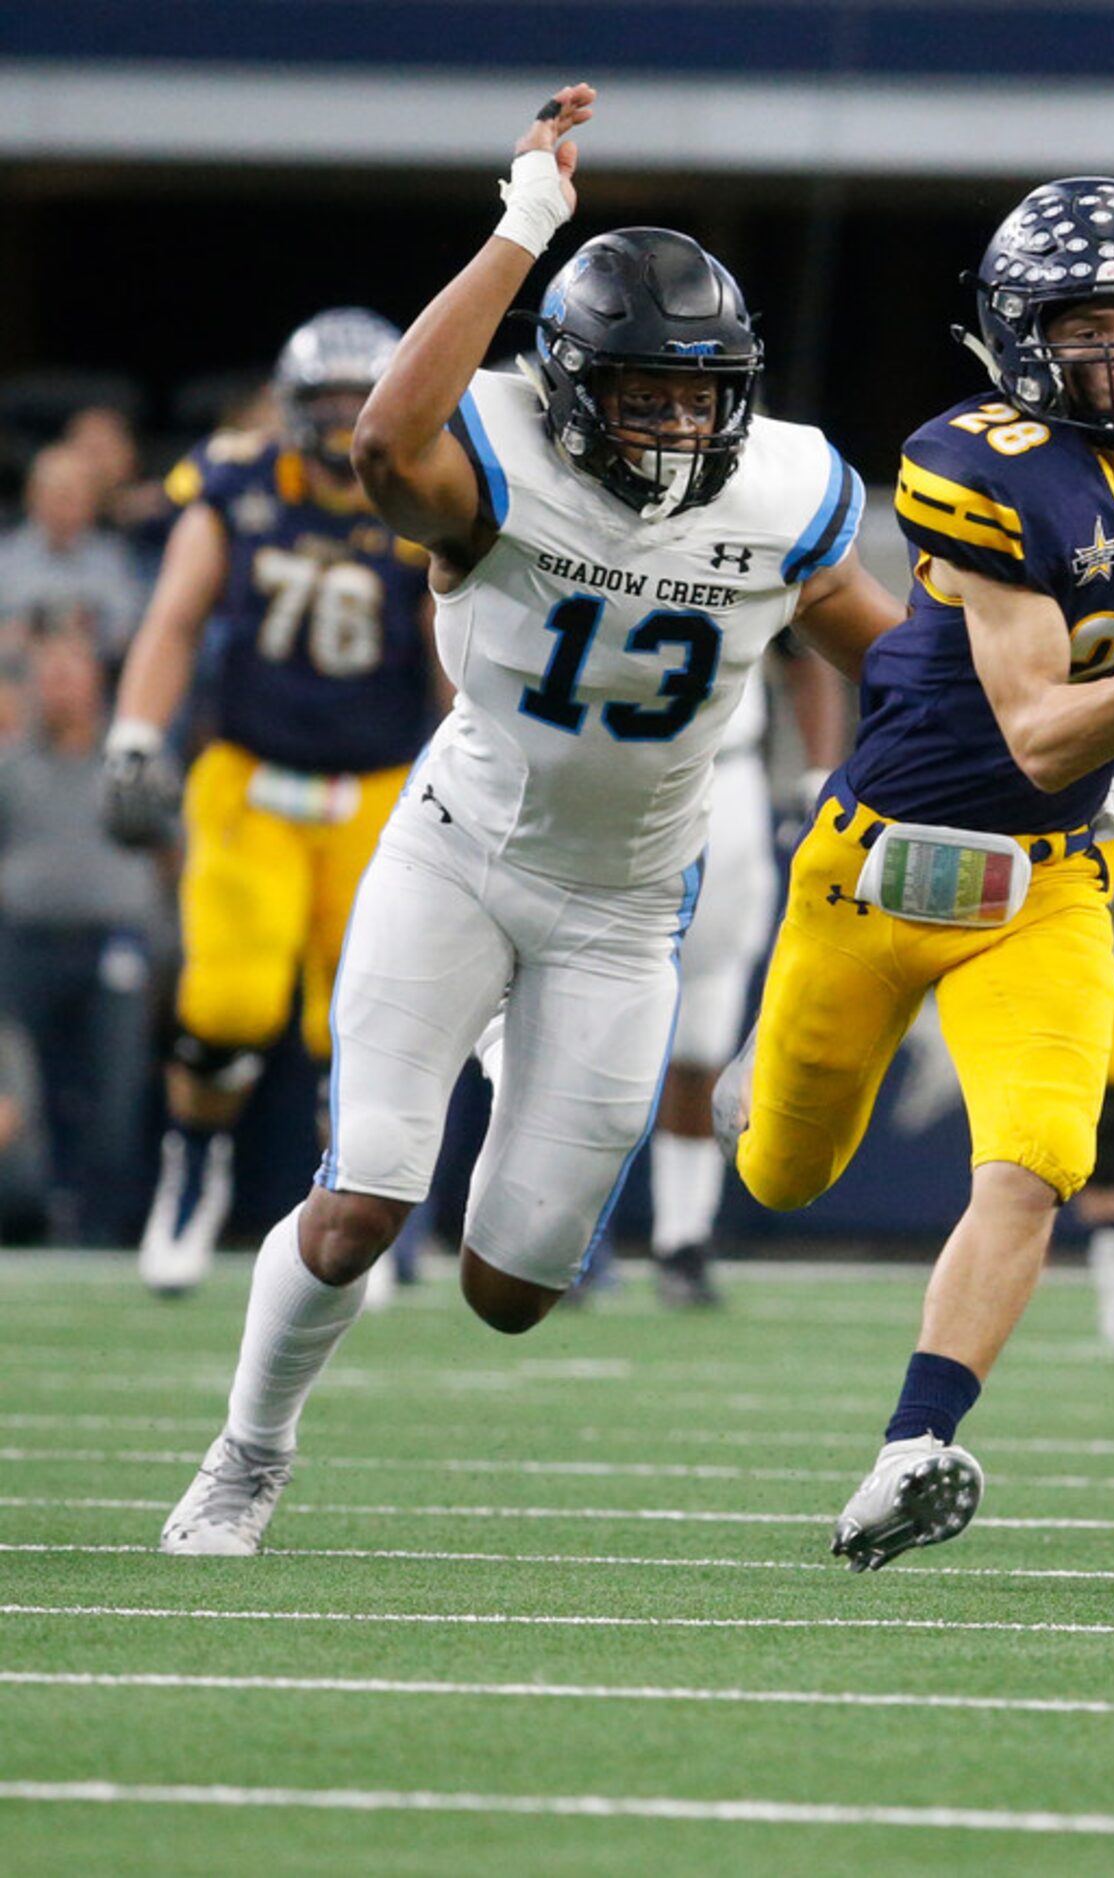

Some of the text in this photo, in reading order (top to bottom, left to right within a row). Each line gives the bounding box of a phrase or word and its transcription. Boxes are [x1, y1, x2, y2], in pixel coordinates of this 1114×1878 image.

[948, 402, 1052, 456] 28
[537, 553, 740, 607] SHADOW CREEK
[517, 591, 724, 742] 13
